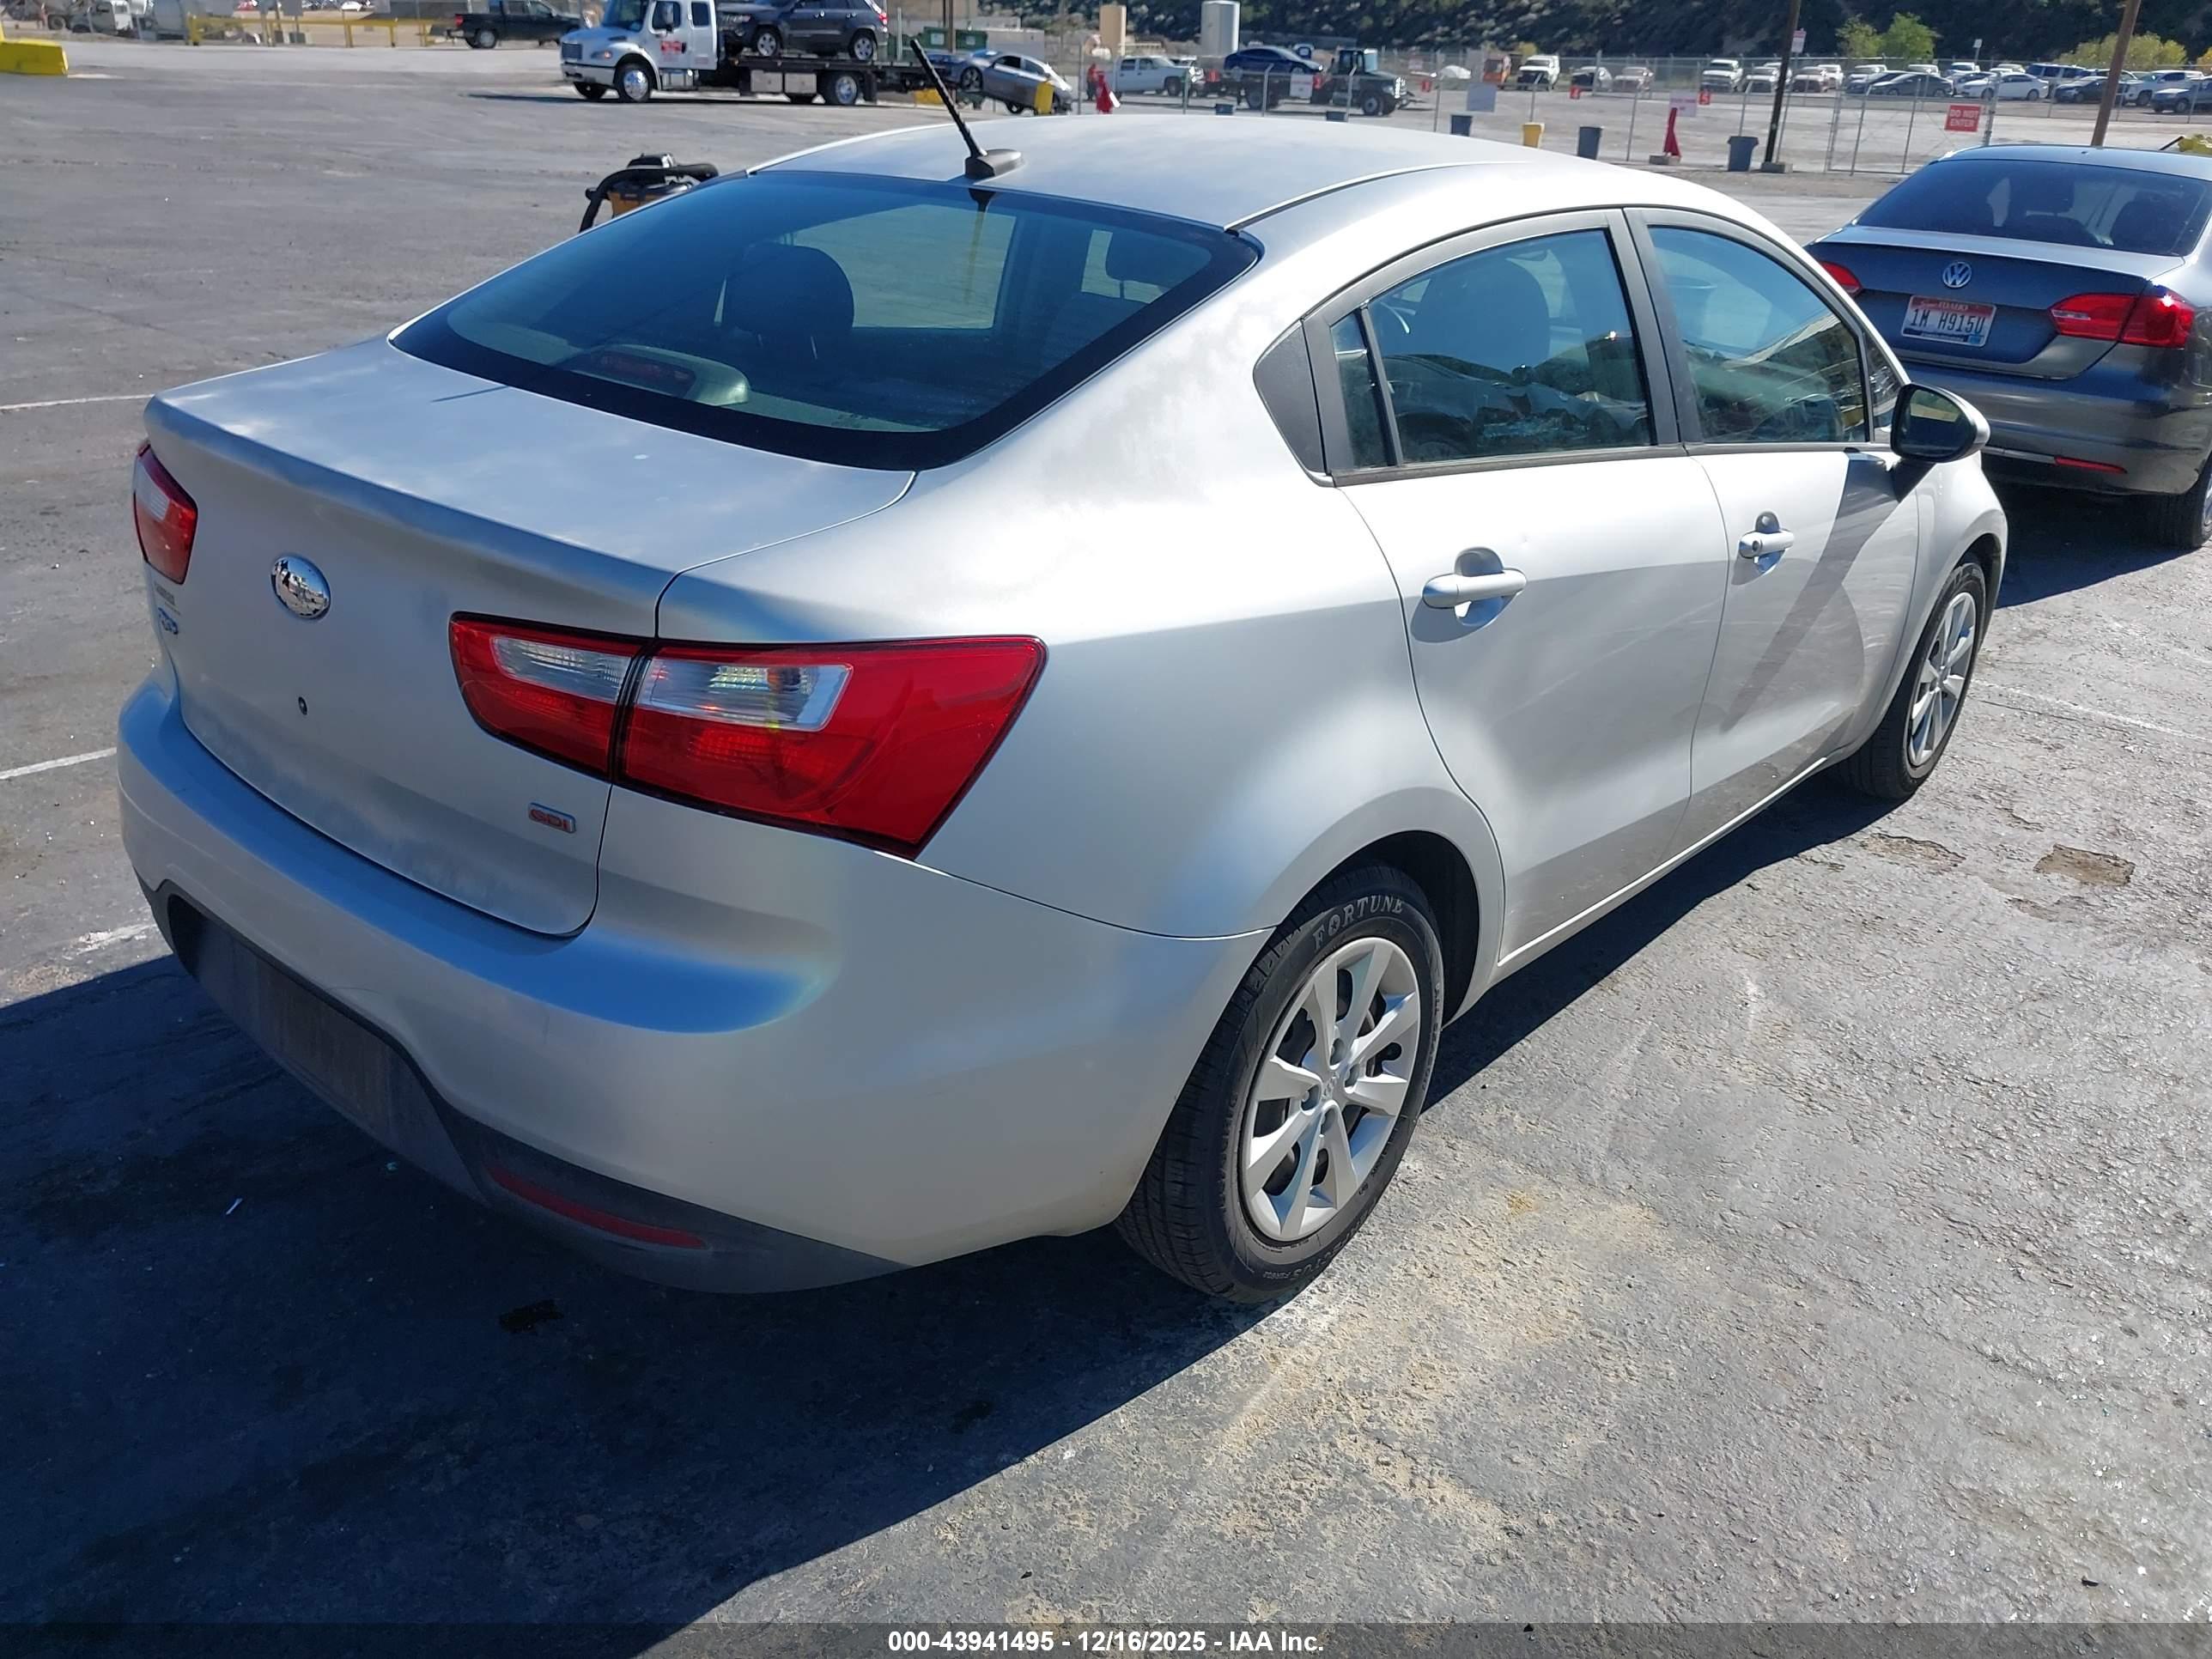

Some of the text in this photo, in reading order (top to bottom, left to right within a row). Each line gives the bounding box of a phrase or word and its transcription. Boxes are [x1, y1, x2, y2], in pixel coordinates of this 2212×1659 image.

[1949, 109, 1979, 119] DO NOT
[1950, 118, 1975, 128] ENTER
[1312, 895, 1403, 951] FORTUNE
